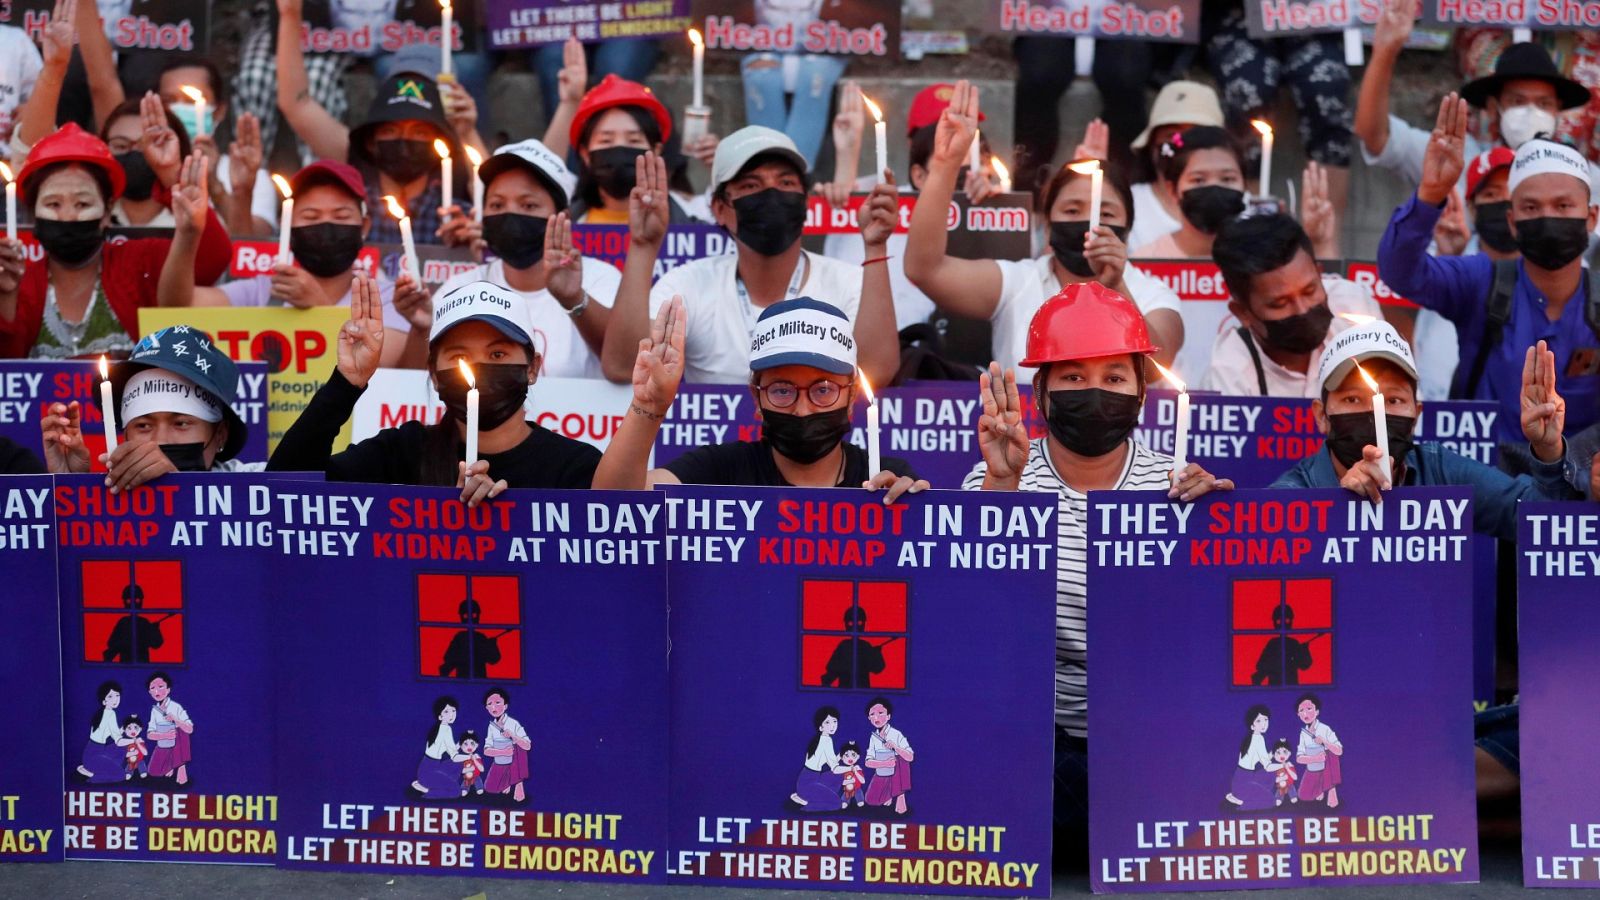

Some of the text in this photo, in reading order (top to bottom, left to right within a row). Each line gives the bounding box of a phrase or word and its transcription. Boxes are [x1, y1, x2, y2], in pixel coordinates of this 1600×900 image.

[510, 9, 540, 26] LET
[545, 5, 597, 23] THERE
[1001, 1, 1183, 37] Head Shot
[1262, 0, 1349, 31] Head
[1437, 0, 1526, 22] Head
[116, 16, 194, 51] Shot
[382, 20, 463, 52] Shot
[493, 27, 520, 45] LET
[705, 16, 888, 55] Head Shot
[967, 207, 1029, 231] mm
[667, 233, 695, 256] IN
[706, 233, 738, 257] DA
[435, 291, 511, 321] Military Coup
[779, 321, 827, 340] Military
[831, 326, 853, 351] Coup
[1336, 331, 1381, 350] Military
[1385, 332, 1409, 356] Coup
[144, 379, 190, 398] Military
[194, 385, 217, 408] Coup
[665, 393, 743, 421] THEY
[915, 399, 976, 426] DAY
[1436, 411, 1497, 438] DAY
[659, 423, 729, 446] THEY
[891, 428, 975, 452] NIGHT
[55, 485, 179, 516] SHOOT
[194, 485, 232, 515] IN
[277, 494, 374, 527] THEY
[389, 497, 516, 532] SHOOT
[532, 502, 570, 532] IN
[587, 503, 661, 534] DAY
[666, 498, 1054, 538] THEY SHOOT IN DAY
[1095, 499, 1469, 535] THEY SHOOT IN DAY
[60, 521, 272, 547] IDNAP AT NIG
[277, 529, 660, 565] THEY KIDNAP AT NIGHT
[666, 535, 1053, 570] THEY KIDNAP AT NIGHT
[1093, 536, 1467, 567] THEY KIDNAP AT NIGHT
[64, 790, 278, 821] HERE BE LIGHT
[323, 803, 622, 840] LET THERE BE LIGHT
[699, 816, 1006, 853] LET THERE BE LIGHT
[1137, 814, 1433, 848] LET THERE BE LIGHT
[106, 826, 139, 850] BE
[148, 826, 276, 853] DEMOCRA
[287, 836, 654, 875] LET THERE BE DEMOCRACY
[667, 850, 1039, 888] LET THERE BE DEMOCRACY
[1102, 848, 1466, 883] LET THERE BE DEMOCRACY
[1536, 856, 1583, 880] LET
